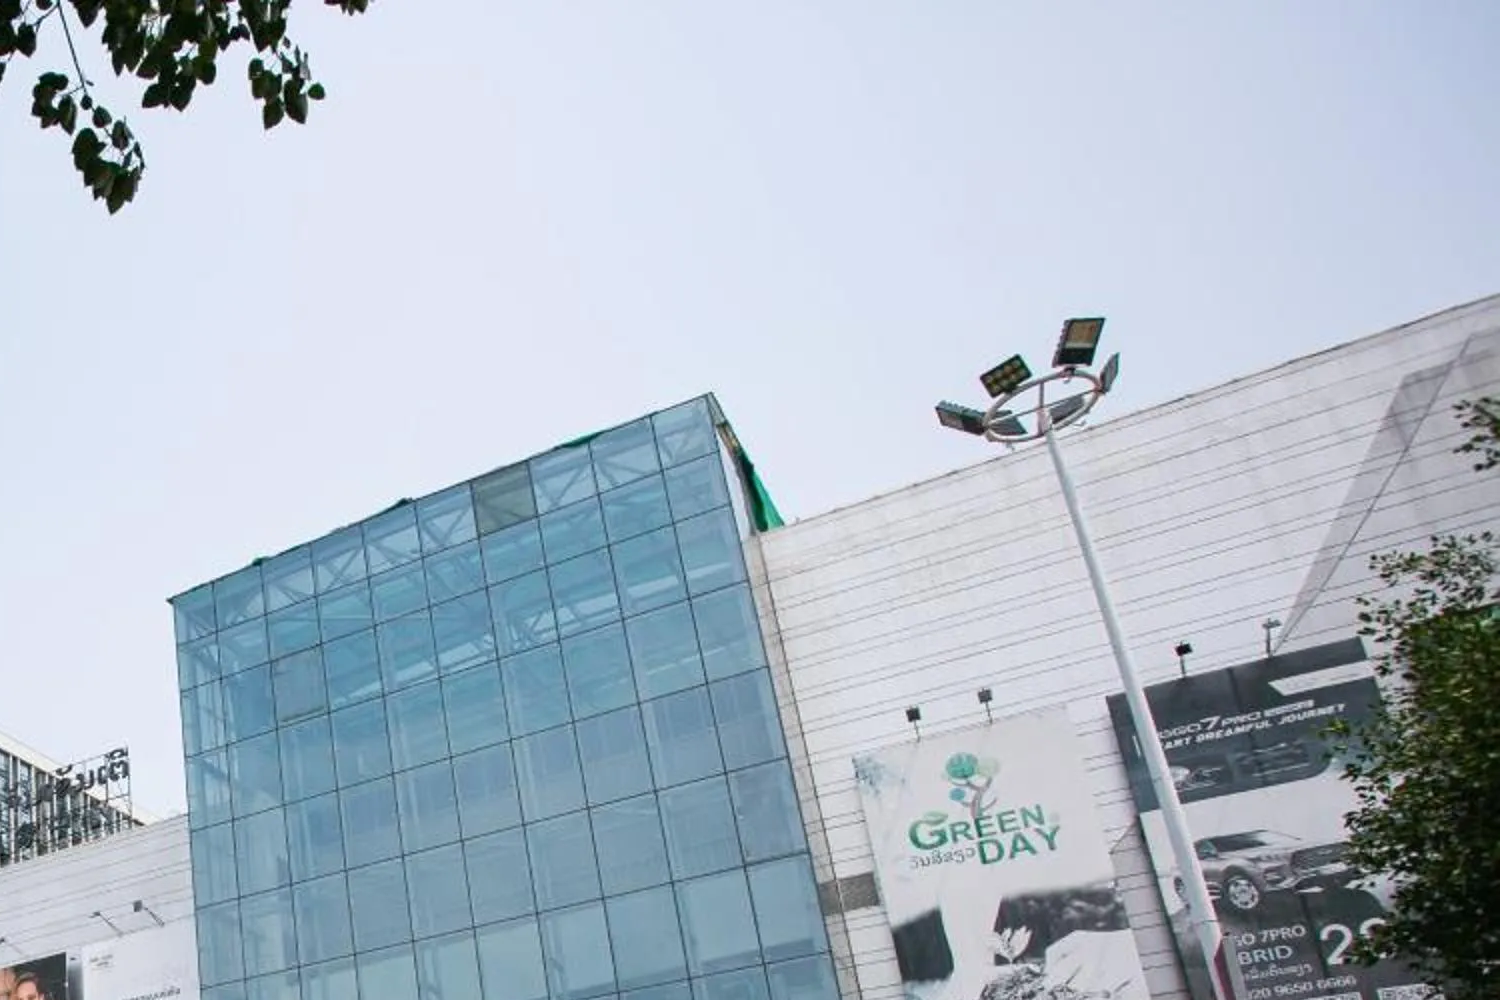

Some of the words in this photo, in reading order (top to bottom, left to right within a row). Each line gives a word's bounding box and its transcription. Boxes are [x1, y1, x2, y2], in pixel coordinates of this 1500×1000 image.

[1196, 720, 1273, 744] DREAMFUL
[1277, 703, 1346, 726] JOURNEY
[909, 804, 1046, 850] GREEN
[977, 825, 1061, 865] DAY
[1237, 945, 1293, 965] BRID
